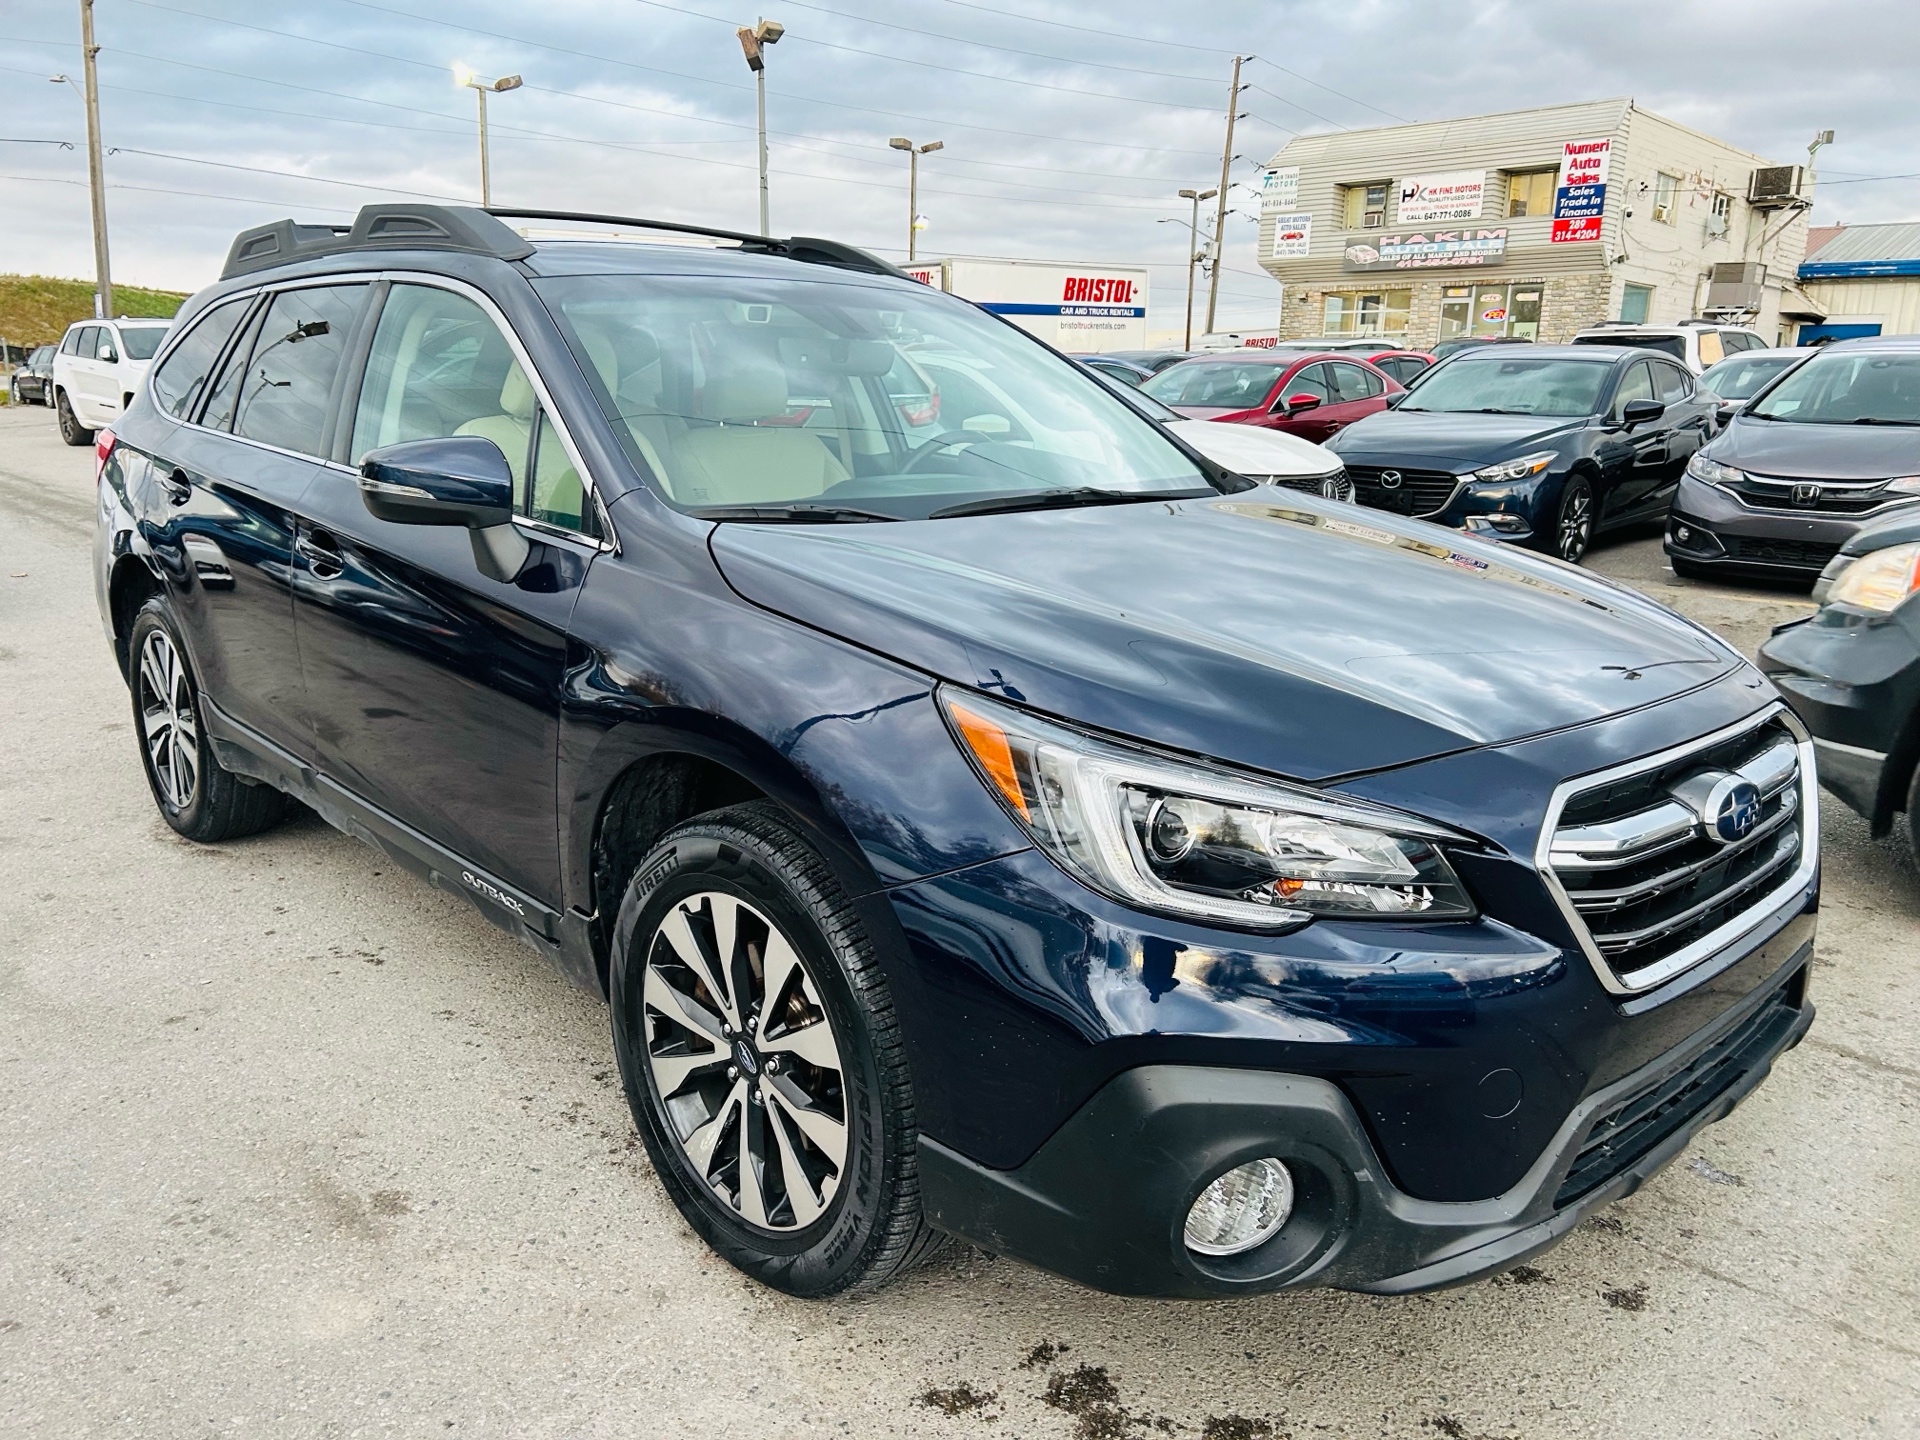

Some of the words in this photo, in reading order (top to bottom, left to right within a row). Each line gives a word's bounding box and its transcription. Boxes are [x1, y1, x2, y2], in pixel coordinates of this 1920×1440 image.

[1565, 139, 1610, 156] Numeri
[1569, 158, 1601, 170] Auto
[1269, 180, 1298, 188] MOTORS
[1566, 172, 1600, 186] Sales
[1439, 186, 1453, 195] FINE
[1455, 184, 1481, 193] MOTORS
[1568, 187, 1595, 196] Sales
[1450, 194, 1465, 202] USED
[1560, 197, 1589, 207] Trade
[1590, 196, 1601, 205] In
[1424, 209, 1472, 220] 647-771-0086
[1559, 208, 1599, 217] Finance
[1292, 215, 1311, 223] MOTORS
[1569, 219, 1587, 230] 289
[1380, 229, 1507, 246] HAKIM
[1555, 229, 1598, 241] 314-4204
[1381, 242, 1438, 255] AUTO
[1445, 239, 1502, 251] SALE
[1063, 277, 1132, 303] BRISTOL
[1060, 306, 1074, 315] CAR
[1074, 307, 1088, 315] AND
[1089, 308, 1109, 316] TRUCK
[1060, 321, 1126, 330] bristoltruckrentals.com
[633, 846, 680, 901] PIRELLI
[462, 871, 525, 915] OUTBACK
